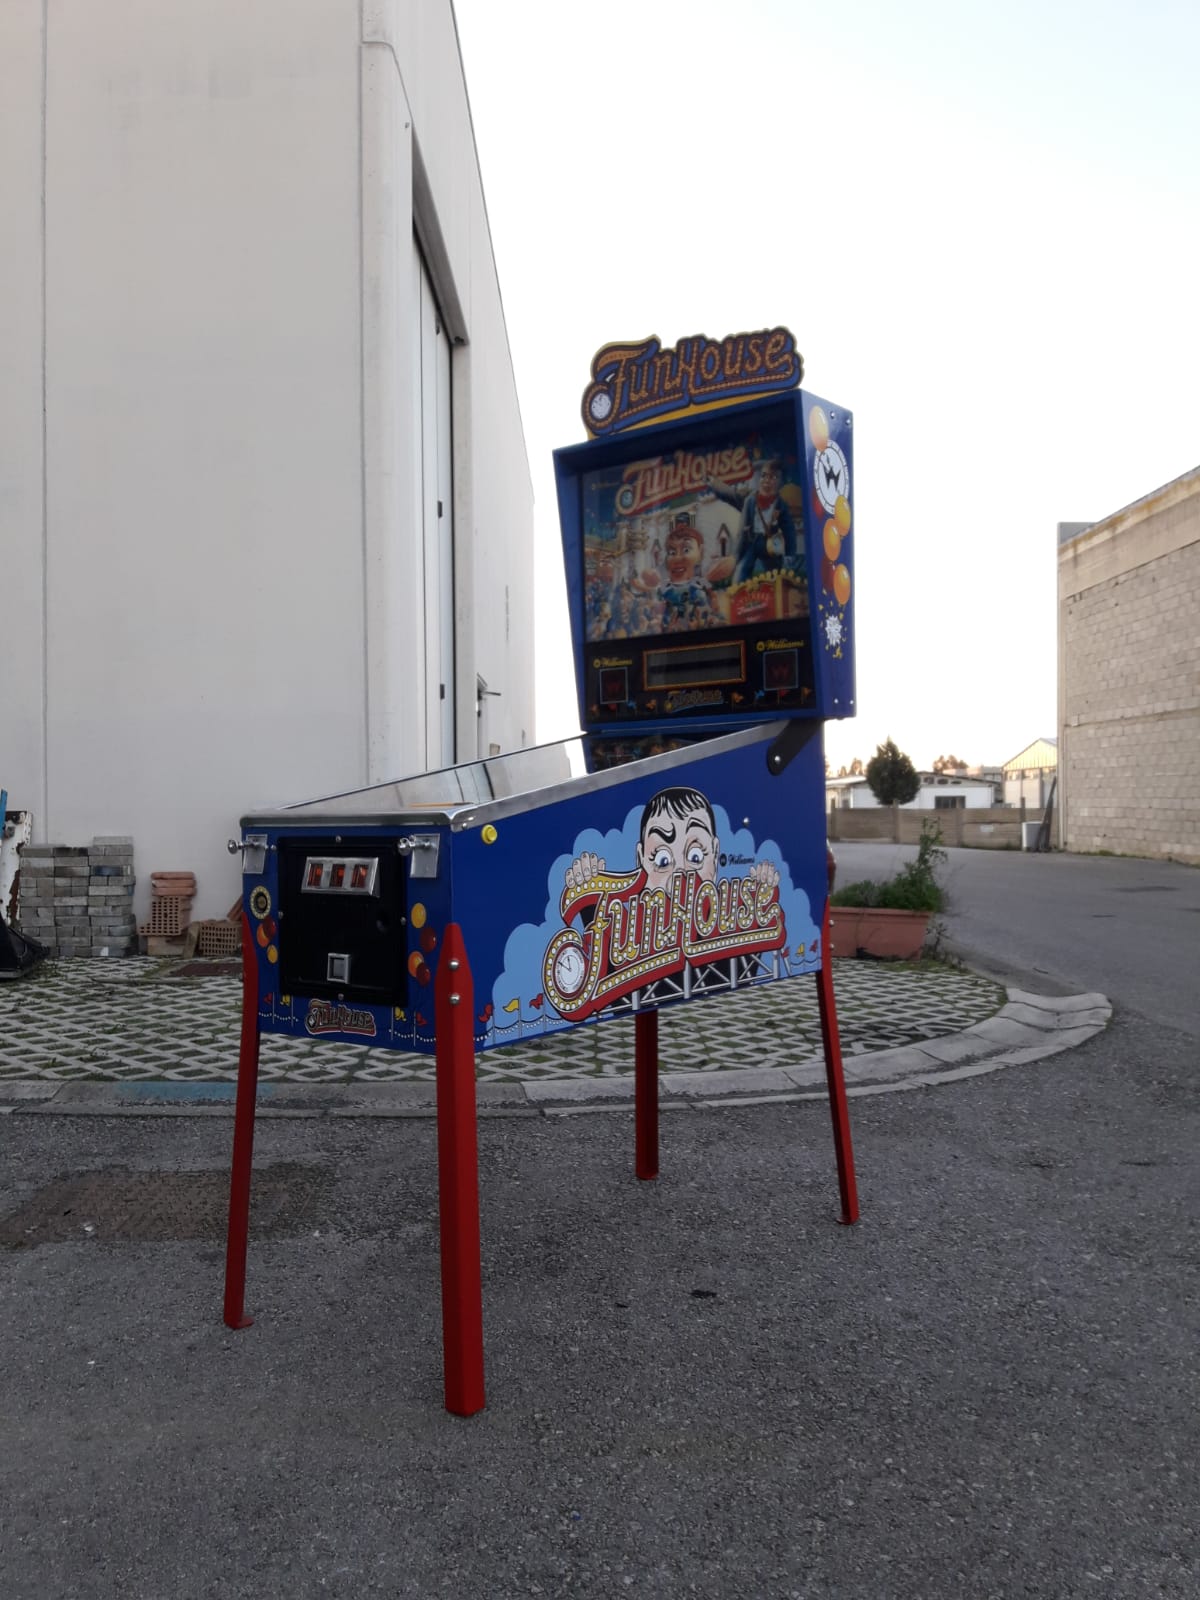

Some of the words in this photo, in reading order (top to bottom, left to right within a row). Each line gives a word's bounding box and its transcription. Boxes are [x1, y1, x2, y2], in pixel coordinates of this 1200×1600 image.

[583, 329, 800, 434] FunHouse
[616, 446, 753, 516] FunHouse
[543, 869, 785, 1020] FunHouse
